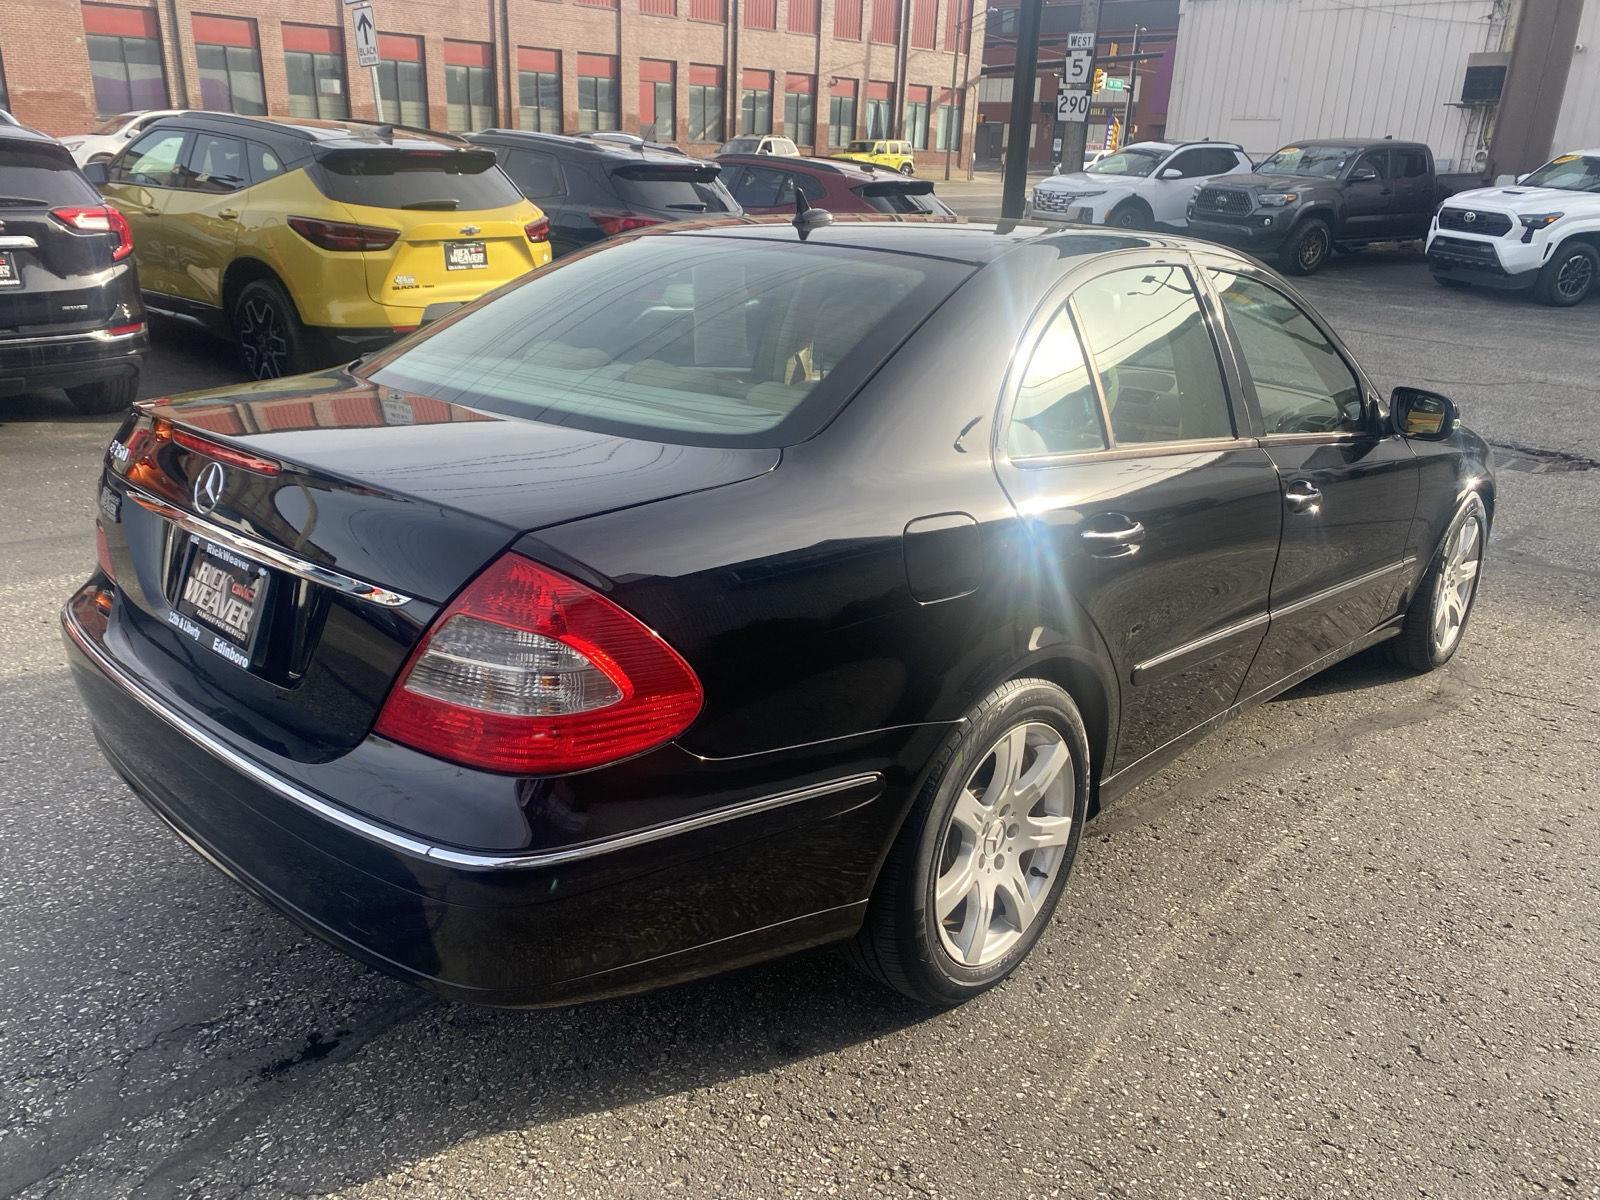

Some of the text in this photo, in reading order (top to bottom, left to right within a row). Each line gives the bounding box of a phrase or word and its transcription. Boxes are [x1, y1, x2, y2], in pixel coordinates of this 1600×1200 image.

[359, 46, 376, 56] BLACK
[1070, 36, 1092, 47] WEST
[1071, 59, 1083, 77] 5
[1059, 95, 1088, 114] 290
[450, 253, 484, 264] WEAVER
[453, 248, 470, 257] RICK
[206, 543, 250, 571] RickWeaver
[196, 561, 235, 592] RICK
[183, 576, 254, 632] WEAVER
[168, 612, 180, 626] 12th
[183, 620, 201, 641] Liberty
[196, 609, 246, 641] FAMOUS FOR SERVICE
[212, 637, 249, 668] Edinboro
